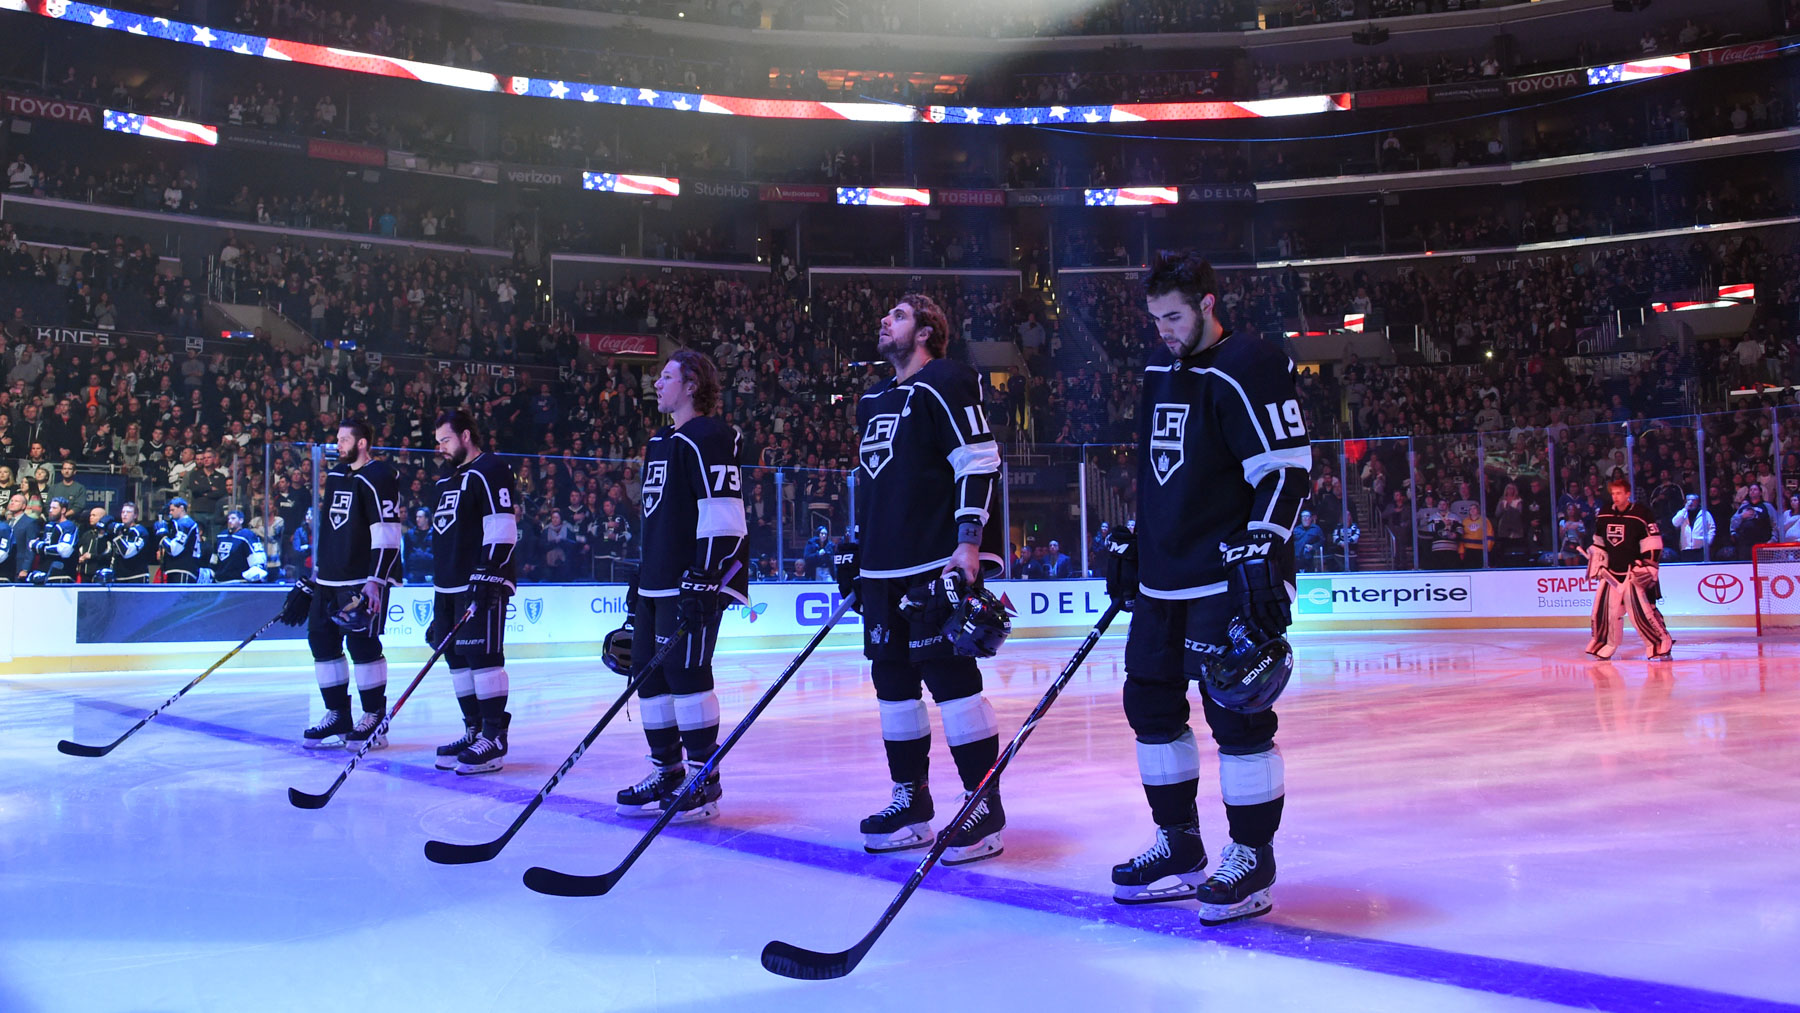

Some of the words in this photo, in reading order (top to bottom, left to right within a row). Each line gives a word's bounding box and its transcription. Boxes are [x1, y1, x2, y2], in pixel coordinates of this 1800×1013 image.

[1507, 73, 1578, 93] TOYOTA
[7, 95, 93, 123] TOYOTA
[508, 171, 562, 185] verizon
[695, 182, 749, 198] StubHub
[940, 192, 1003, 204] TOSHIBA
[1204, 188, 1254, 199] DELTA
[37, 328, 109, 345] KINGS
[963, 404, 991, 437] 11
[1154, 410, 1184, 437] LA
[1264, 398, 1306, 441] 19
[863, 419, 895, 442] LA
[647, 466, 665, 485] LA
[710, 464, 741, 491] 73
[86, 490, 115, 502] GHT
[333, 492, 349, 509] LA
[438, 492, 456, 509] LA
[499, 487, 512, 507] 8
[1222, 541, 1272, 566] CM
[681, 581, 719, 592] CCM
[1307, 583, 1468, 607] enterprise
[1537, 577, 1599, 593] STAPLE
[1750, 575, 1800, 599] TO
[796, 592, 865, 626] GE
[1537, 596, 1593, 608] Business
[1242, 656, 1272, 686] KINGS
[346, 713, 392, 774] EASTON
